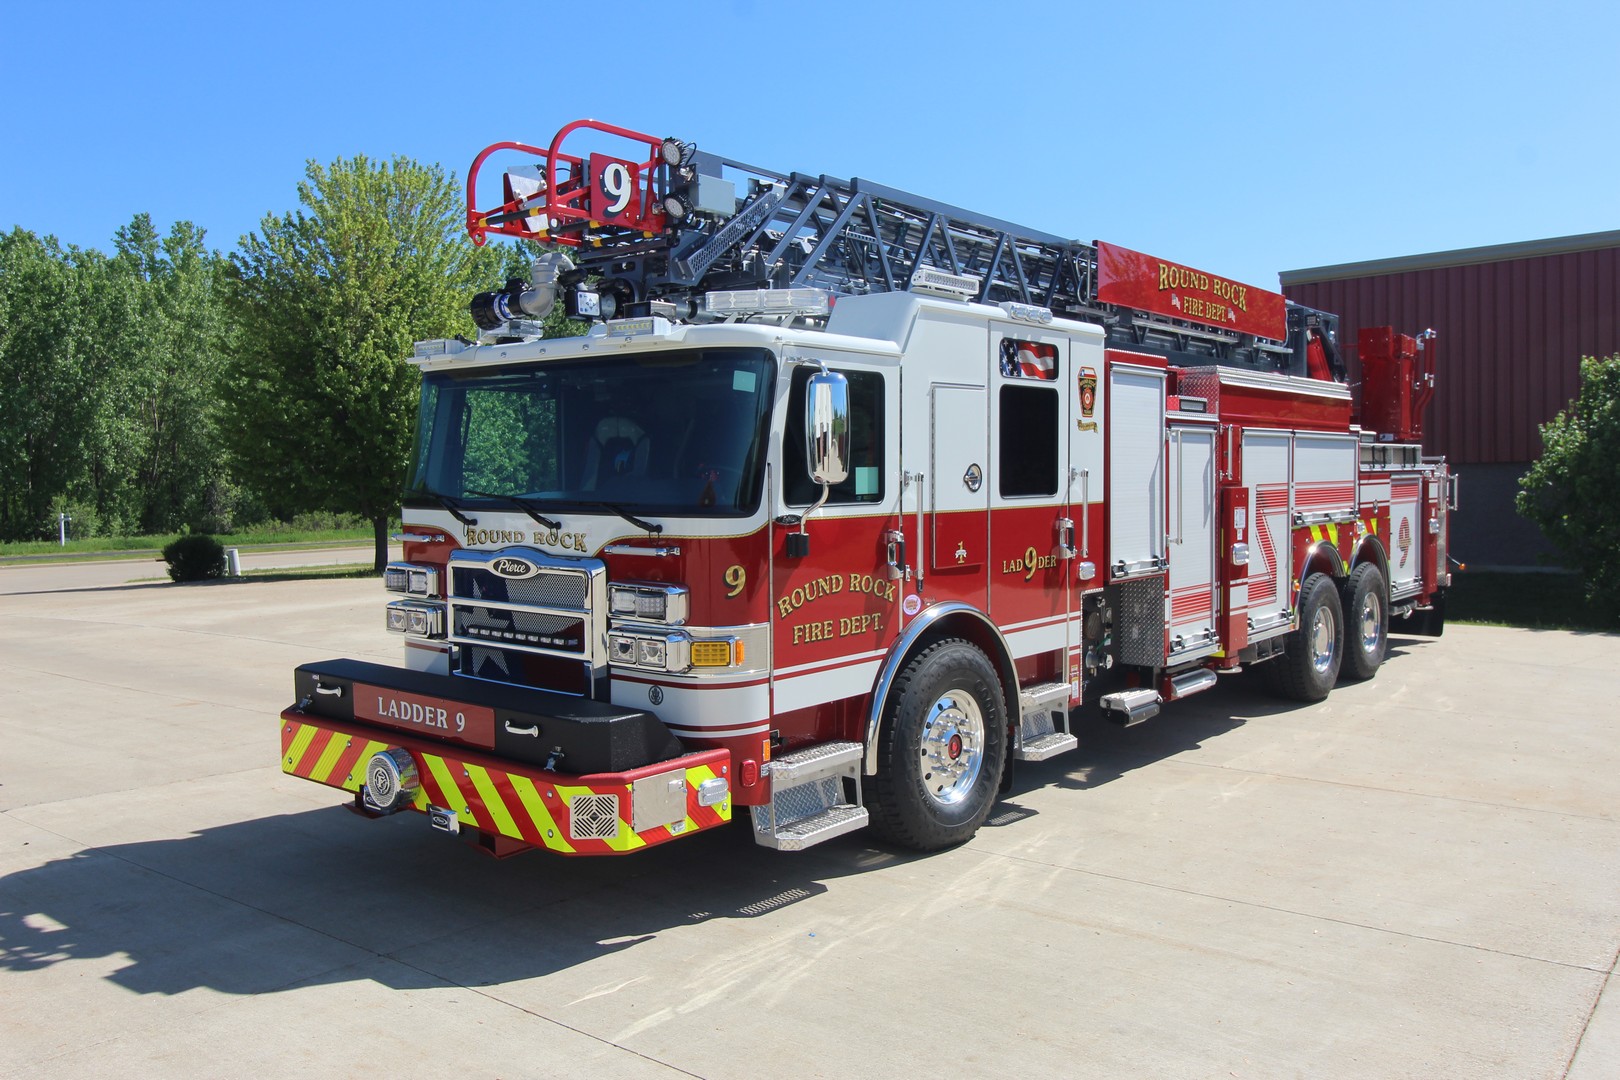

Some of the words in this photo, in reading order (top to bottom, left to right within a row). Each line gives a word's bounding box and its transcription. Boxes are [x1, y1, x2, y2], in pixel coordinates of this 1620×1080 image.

[603, 162, 632, 213] 9
[1158, 263, 1209, 291] ROUND
[1213, 278, 1247, 312] ROCK
[1183, 296, 1204, 317] FIRE
[467, 527, 526, 546] ROUND
[533, 531, 588, 553] ROCK
[498, 559, 526, 573] Pierce
[1024, 546, 1037, 580] 9
[725, 564, 746, 597] 9
[777, 574, 844, 618] ROUND
[849, 573, 896, 603] ROCK
[792, 620, 835, 645] FIRE
[839, 612, 884, 637] DEPT.
[377, 696, 448, 729] LADDER
[455, 712, 466, 732] 9
